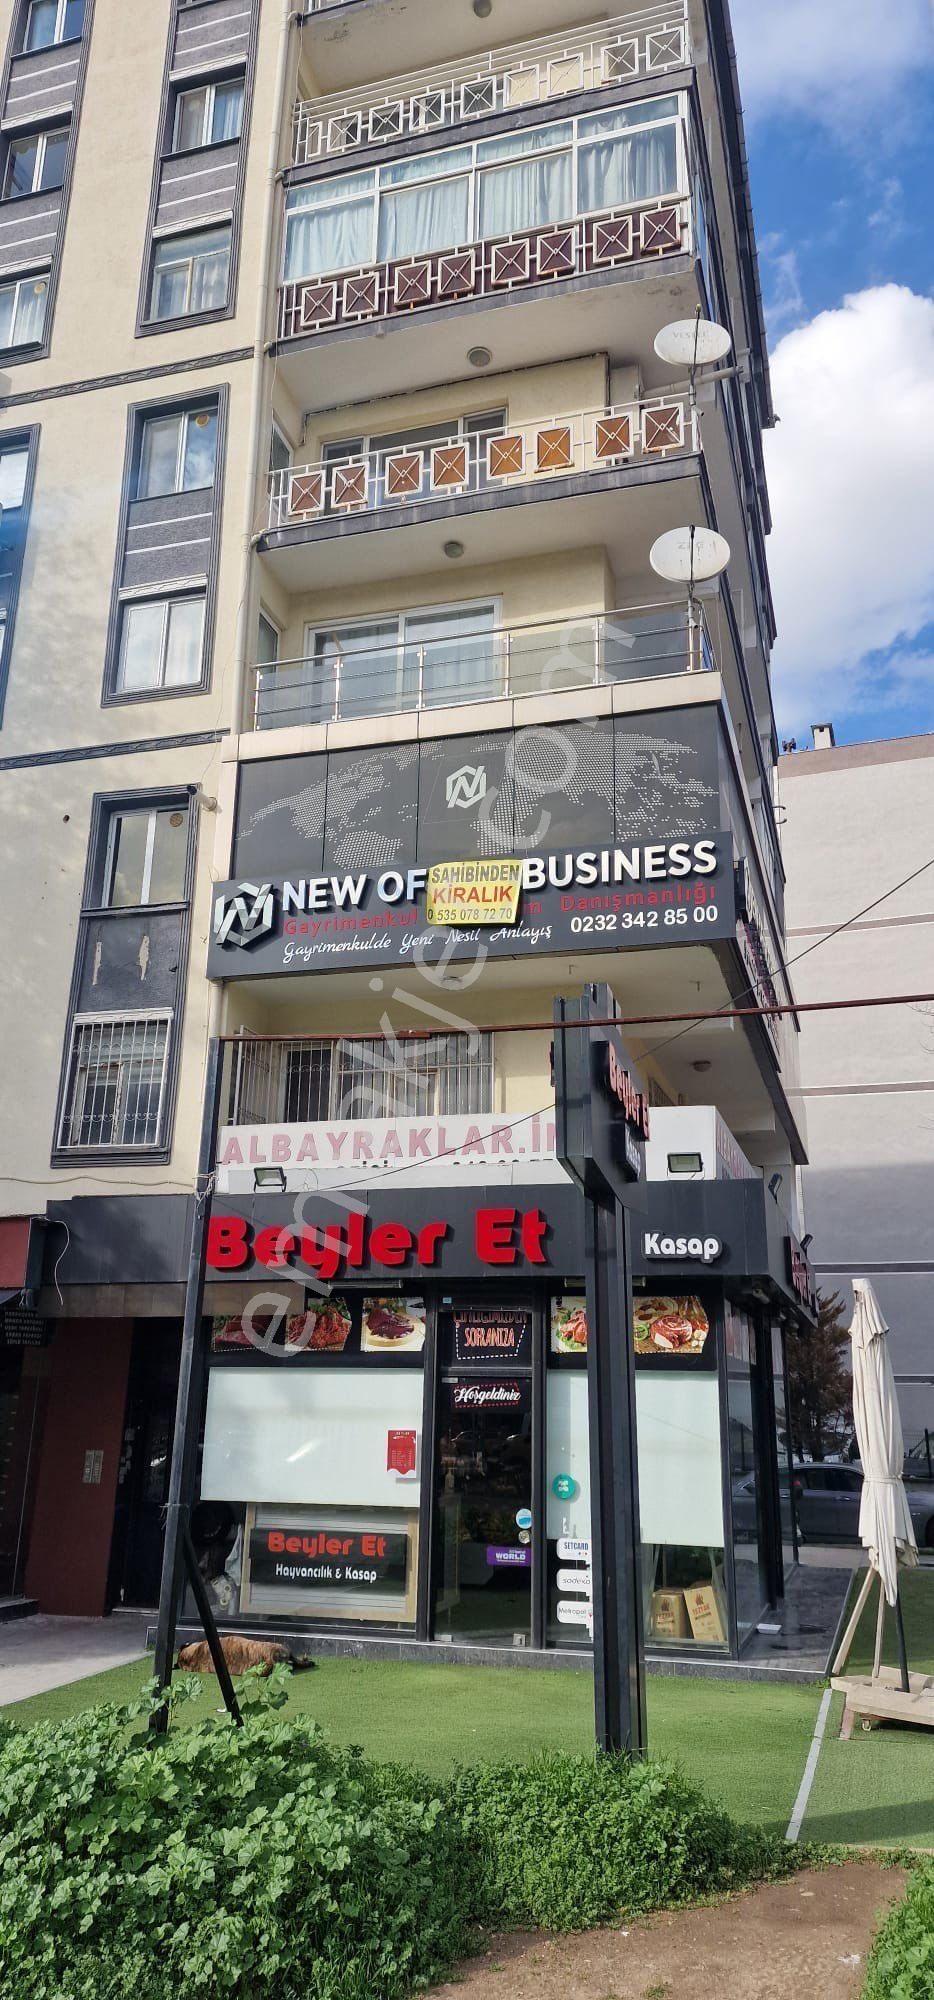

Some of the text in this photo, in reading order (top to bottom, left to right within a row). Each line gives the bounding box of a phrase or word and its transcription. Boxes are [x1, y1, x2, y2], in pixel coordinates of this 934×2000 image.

[281, 873, 369, 911] NEW
[522, 840, 718, 890] BUSINESS
[431, 862, 520, 883] SAHİBİNDEN
[432, 884, 513, 904] KİRALIK
[283, 908, 419, 938] Gayrimenkul
[560, 881, 716, 913] Danışmanlığı
[427, 909, 434, 920] 0
[437, 908, 457, 921] 535
[460, 908, 479, 920] 078
[483, 908, 496, 920] 72
[499, 907, 513, 919] 70
[570, 905, 718, 933] 0232 342 85 00
[282, 920, 553, 964] Gayrimenkulde Yeni Nesil Anlayış
[206, 1208, 547, 1279] Beyler Et
[643, 1233, 720, 1260] Kasap
[453, 1385, 521, 1405] Hoşgeldiniz
[267, 1531, 387, 1558] Beyler Et
[495, 1552, 526, 1560] WORLD
[563, 1541, 589, 1551] SETCARD
[275, 1563, 377, 1584] Hayvancılık & Kasap
